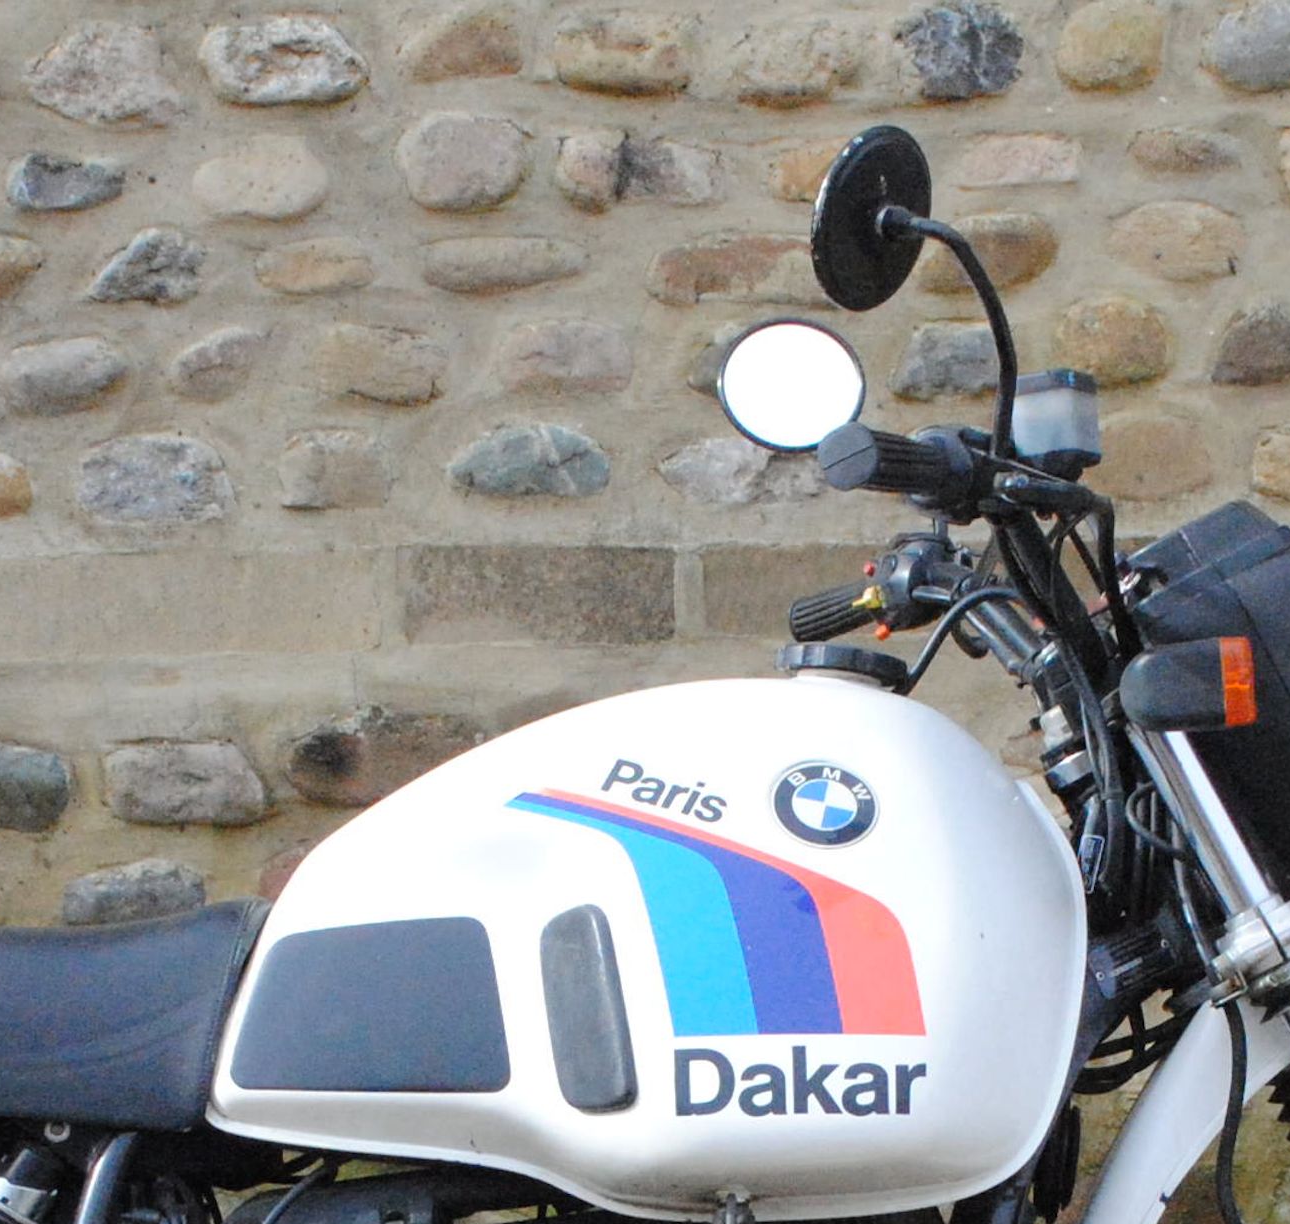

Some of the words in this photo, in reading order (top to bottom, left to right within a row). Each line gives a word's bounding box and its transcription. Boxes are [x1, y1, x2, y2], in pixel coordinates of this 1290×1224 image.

[601, 758, 728, 823] Paris
[787, 767, 872, 800] BMW
[673, 1046, 927, 1118] Dakar
